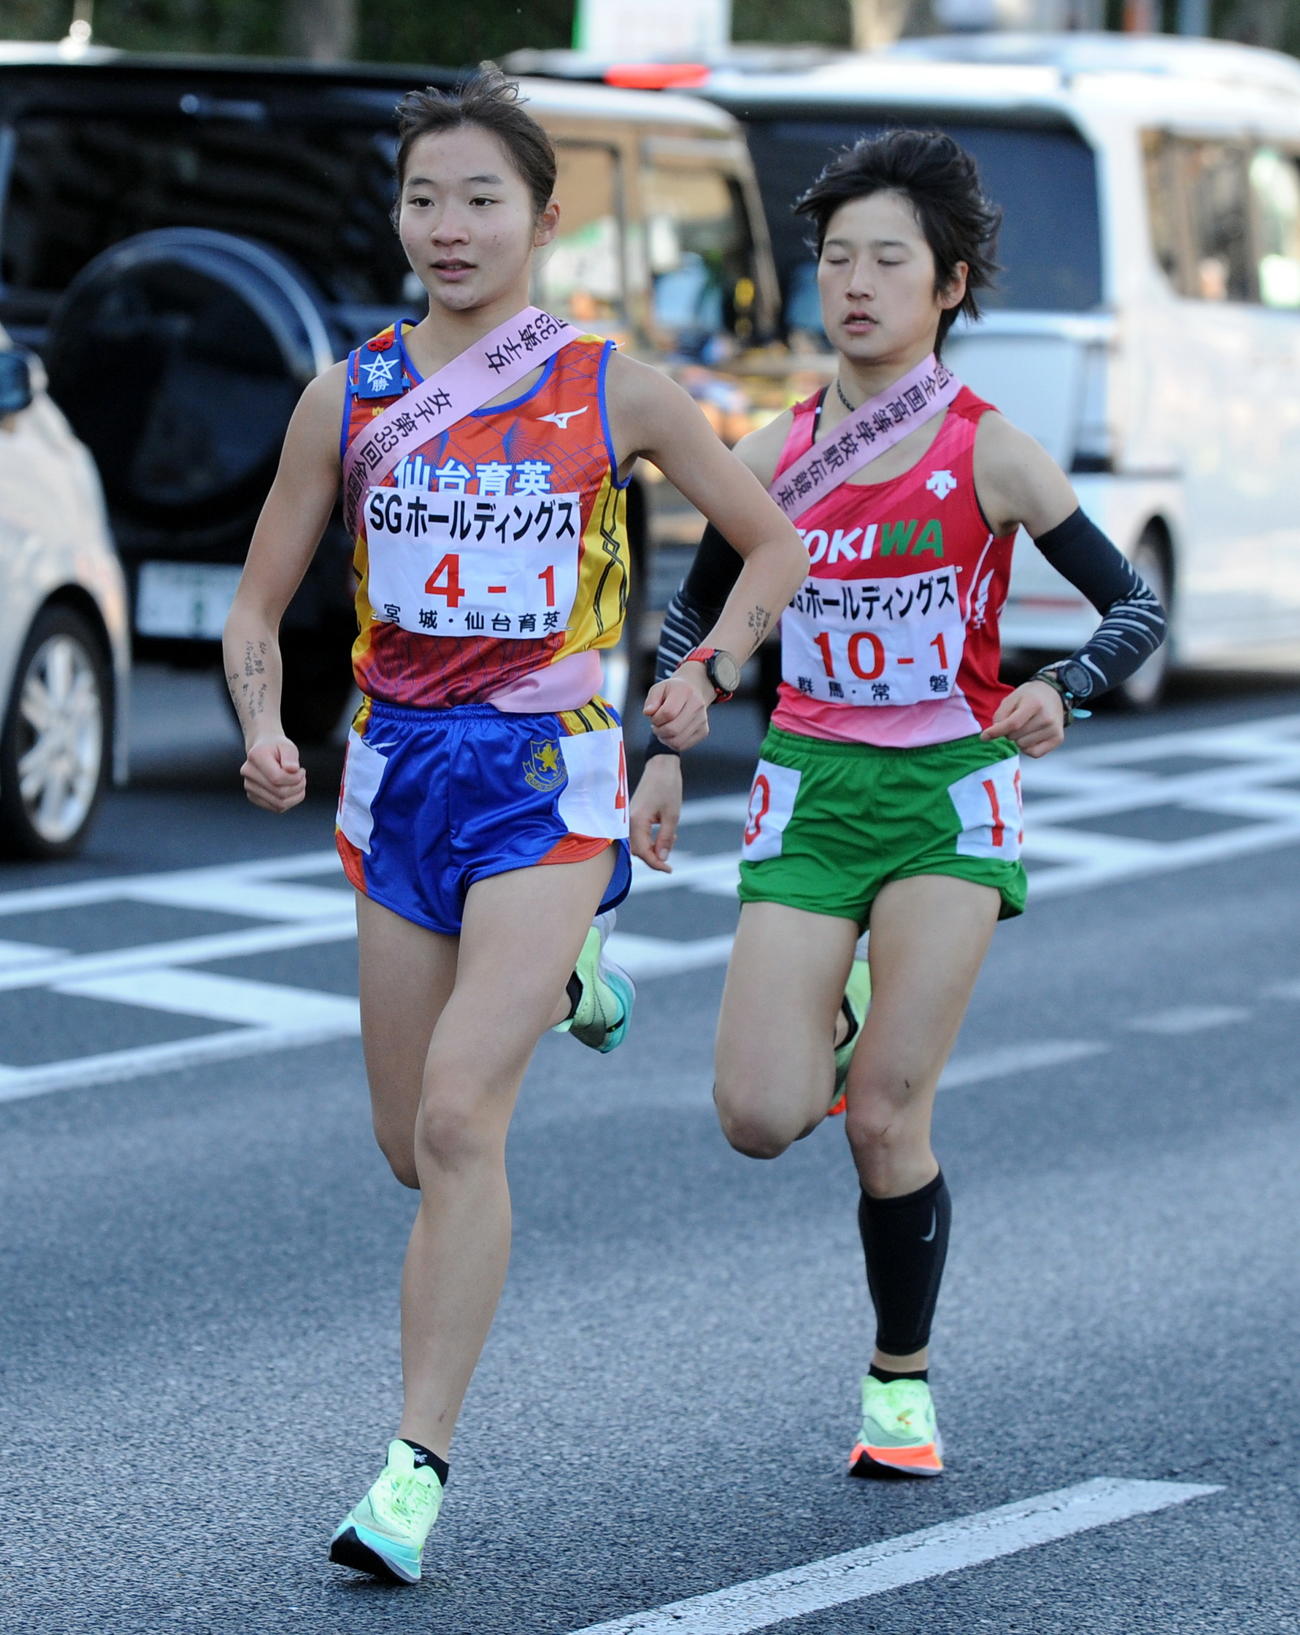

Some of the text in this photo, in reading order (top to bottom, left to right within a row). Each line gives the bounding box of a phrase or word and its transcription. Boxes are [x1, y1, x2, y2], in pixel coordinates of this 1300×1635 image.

[777, 362, 954, 512] 回全国高等学校駅伝競走
[393, 454, 552, 495] 仙台育英
[369, 492, 576, 545] SGホールディングス
[789, 575, 955, 621] ホールディングス
